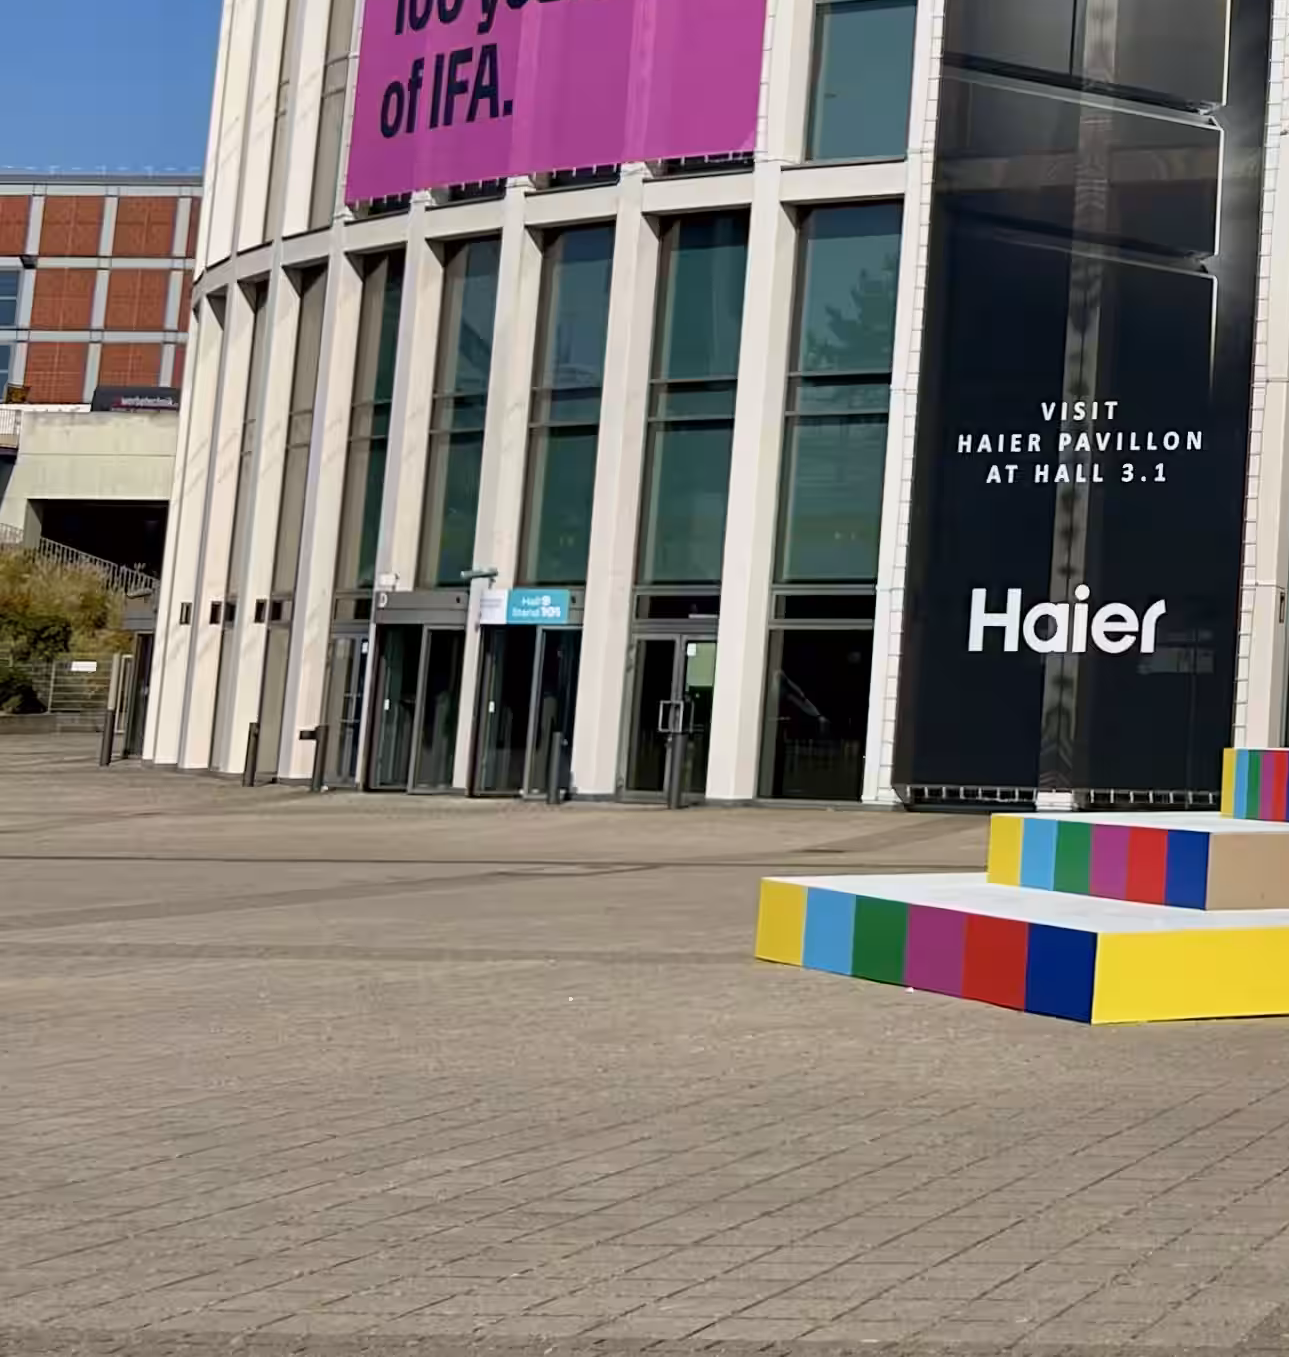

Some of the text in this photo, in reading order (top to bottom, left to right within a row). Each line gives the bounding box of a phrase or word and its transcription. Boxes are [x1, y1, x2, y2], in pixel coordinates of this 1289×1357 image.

[380, 42, 514, 139] of IFA.
[1041, 400, 1119, 422] VISIT
[957, 430, 1204, 454] HAIER PAVILLON
[986, 462, 1167, 484] AT HALL 3.1
[968, 583, 1167, 654] Haier
